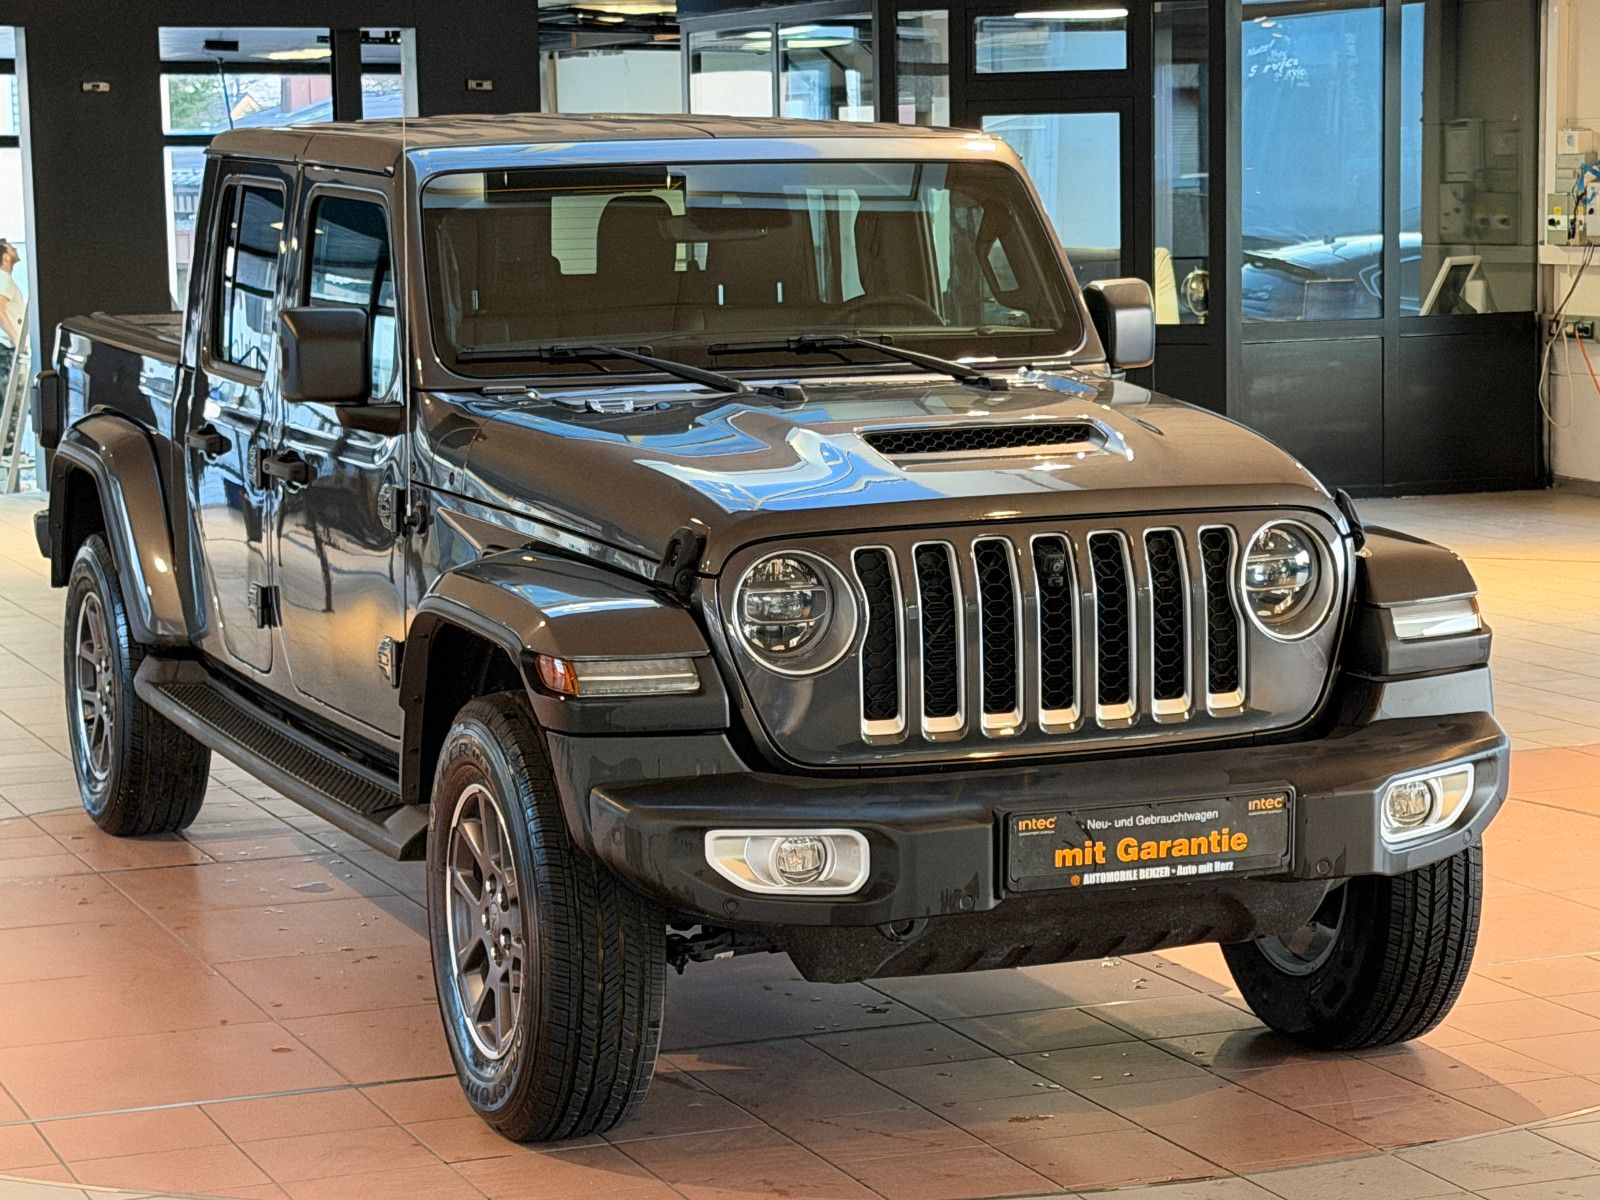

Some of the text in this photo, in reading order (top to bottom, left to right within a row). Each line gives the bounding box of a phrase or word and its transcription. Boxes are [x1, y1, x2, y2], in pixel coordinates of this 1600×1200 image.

[1087, 810, 1219, 830] Neu- und Gebrauchtwagen
[1055, 827, 1249, 868] mit Garantie
[1082, 869, 1139, 885] AUTOMOBILE
[1176, 864, 1198, 877] Auto
[1198, 861, 1213, 874] mit
[1213, 860, 1235, 873] Herz
